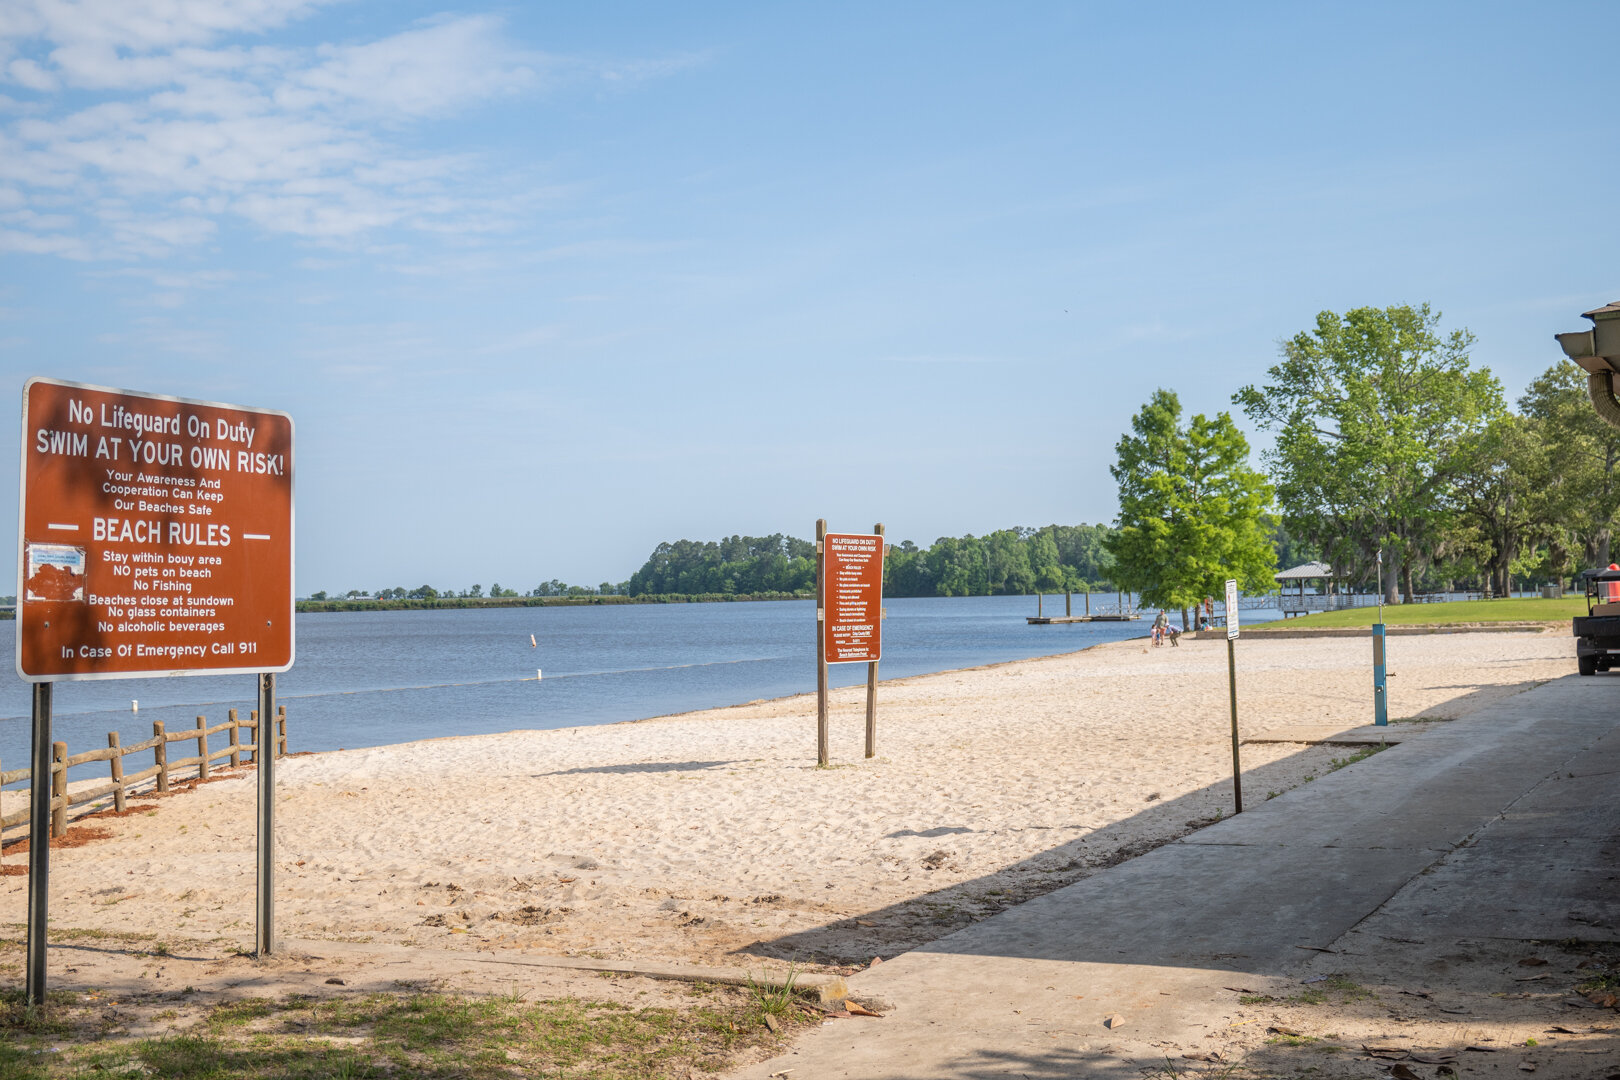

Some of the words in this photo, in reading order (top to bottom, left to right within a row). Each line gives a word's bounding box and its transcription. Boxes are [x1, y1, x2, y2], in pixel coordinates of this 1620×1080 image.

[69, 400, 93, 424] No
[101, 404, 180, 437] Lifeguard
[188, 415, 210, 439] On
[218, 419, 255, 448] Duty
[37, 429, 87, 457] SWIM
[96, 438, 122, 460] AT
[129, 440, 182, 466] YOUR
[191, 447, 230, 471] OWN
[238, 452, 284, 475] RISK!
[107, 469, 134, 482] Your
[138, 472, 195, 487] Awareness
[200, 477, 221, 489] And
[103, 483, 168, 498] Cooperation
[173, 488, 193, 499] Can
[197, 489, 224, 503] Keep
[115, 500, 134, 510] Our
[139, 502, 185, 514] Beaches
[189, 504, 212, 515] Safe
[93, 518, 161, 543] BEACH
[169, 522, 230, 546] RULES
[103, 551, 128, 564] Stay
[133, 552, 164, 564] within
[168, 553, 194, 566] bouy
[198, 555, 222, 565] area
[113, 566, 130, 576] NO
[135, 567, 158, 578] pets
[162, 568, 175, 577] on
[179, 567, 211, 578] beach
[134, 581, 148, 590] No
[153, 581, 192, 593] Fishing
[89, 595, 136, 606] Beaches
[140, 596, 168, 606] close
[173, 597, 183, 606] at
[187, 595, 234, 606] sundown
[108, 607, 124, 617] No
[128, 607, 156, 619] glass
[160, 607, 216, 617] containers
[98, 622, 113, 632] No
[118, 621, 165, 632] alcoholic
[170, 621, 225, 633] beverages
[62, 646, 74, 658] In
[80, 646, 112, 657] Case
[118, 645, 132, 656] Of
[137, 644, 207, 659] Emergency
[212, 643, 234, 654] Call
[239, 642, 257, 654] 911
